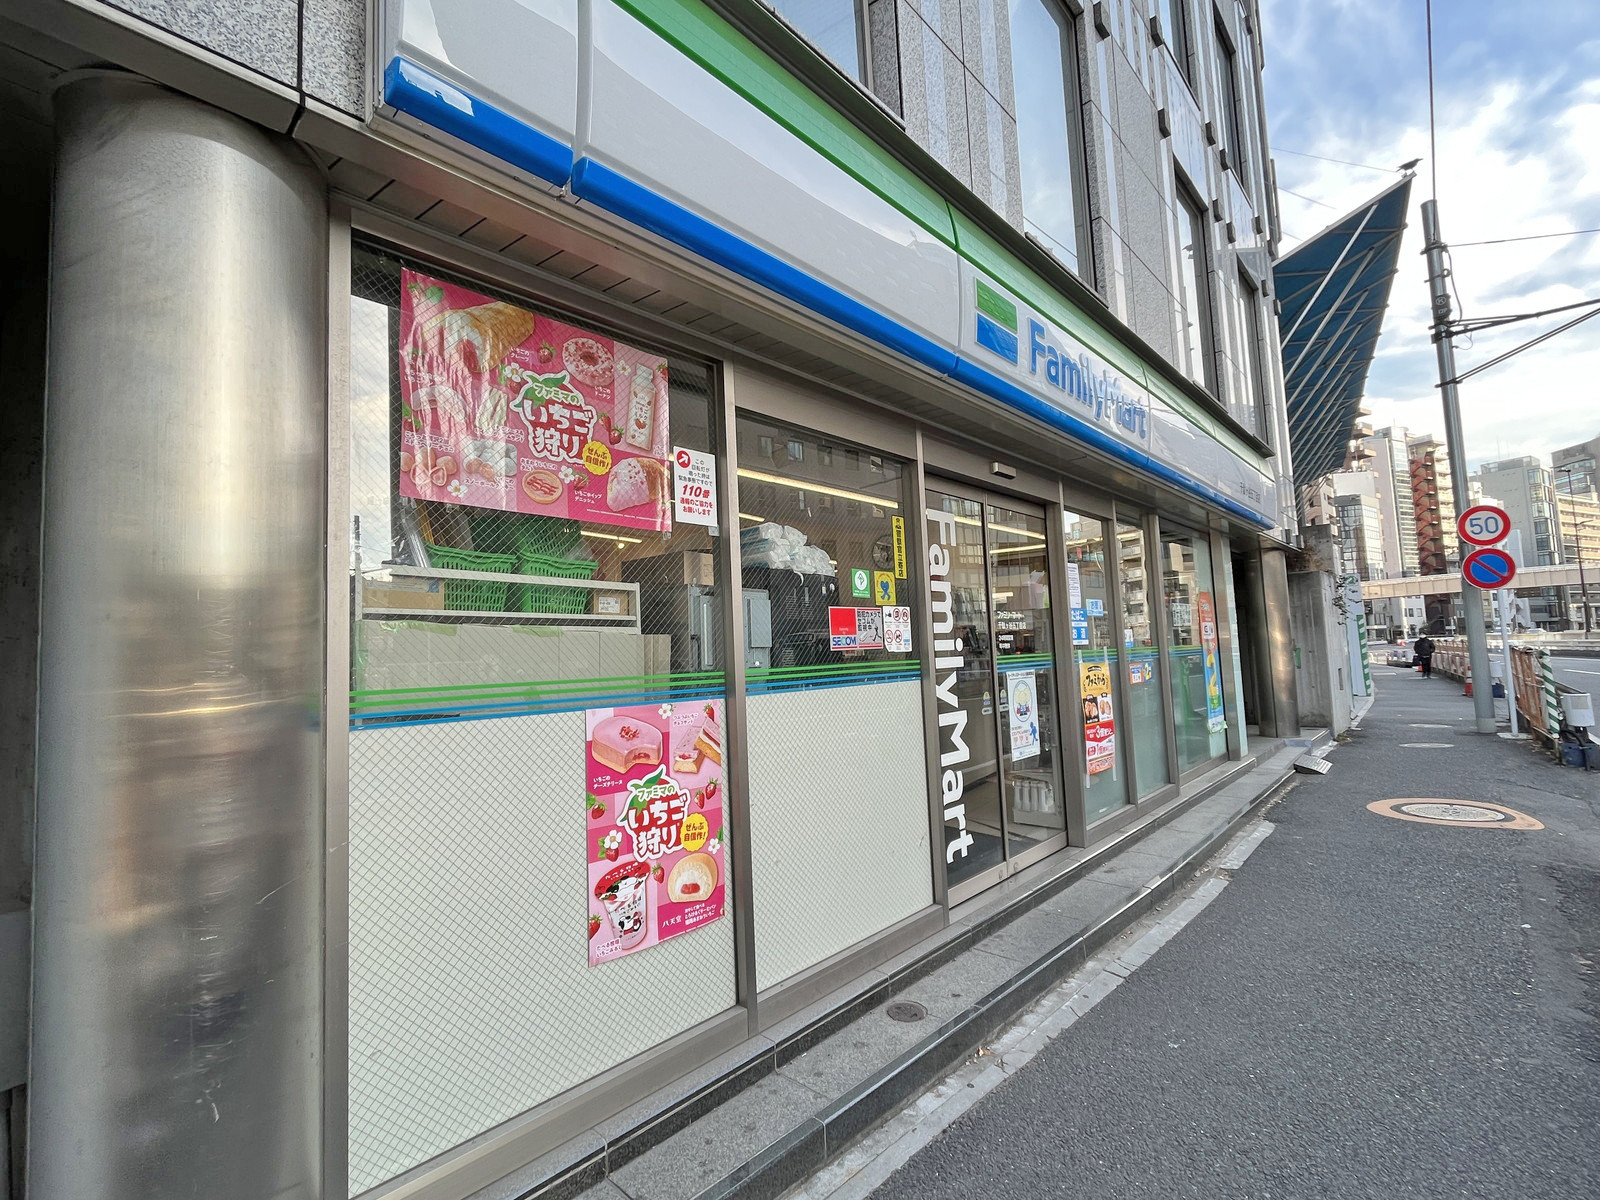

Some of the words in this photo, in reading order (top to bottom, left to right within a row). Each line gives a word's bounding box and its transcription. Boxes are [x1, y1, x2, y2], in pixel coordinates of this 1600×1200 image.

[1029, 317, 1147, 439] FamilyMart
[533, 383, 581, 406] ファミマの
[524, 399, 593, 430] いちご
[534, 427, 580, 457] 狩り
[587, 447, 608, 460] ぜんぶ
[586, 455, 610, 470] 自信作!
[695, 458, 705, 466] この
[691, 464, 710, 474] 回転灯が
[682, 484, 710, 499] 110番
[680, 496, 713, 509] 通報のご協力を
[682, 505, 712, 517] お願いします
[1469, 516, 1499, 536] 50
[1071, 609, 1085, 621] たばこ
[832, 636, 857, 647] SECOM
[926, 508, 976, 864] FamilyMart
[593, 775, 611, 783] いちごの
[593, 780, 623, 789] チーズテリーヌ
[637, 784, 676, 801] ファミマの
[628, 794, 687, 830] いちご
[685, 821, 705, 831] ぜんぶ
[638, 825, 678, 858] 狩り
[684, 830, 707, 842] 自信作!
[662, 915, 682, 928] 八天堂
